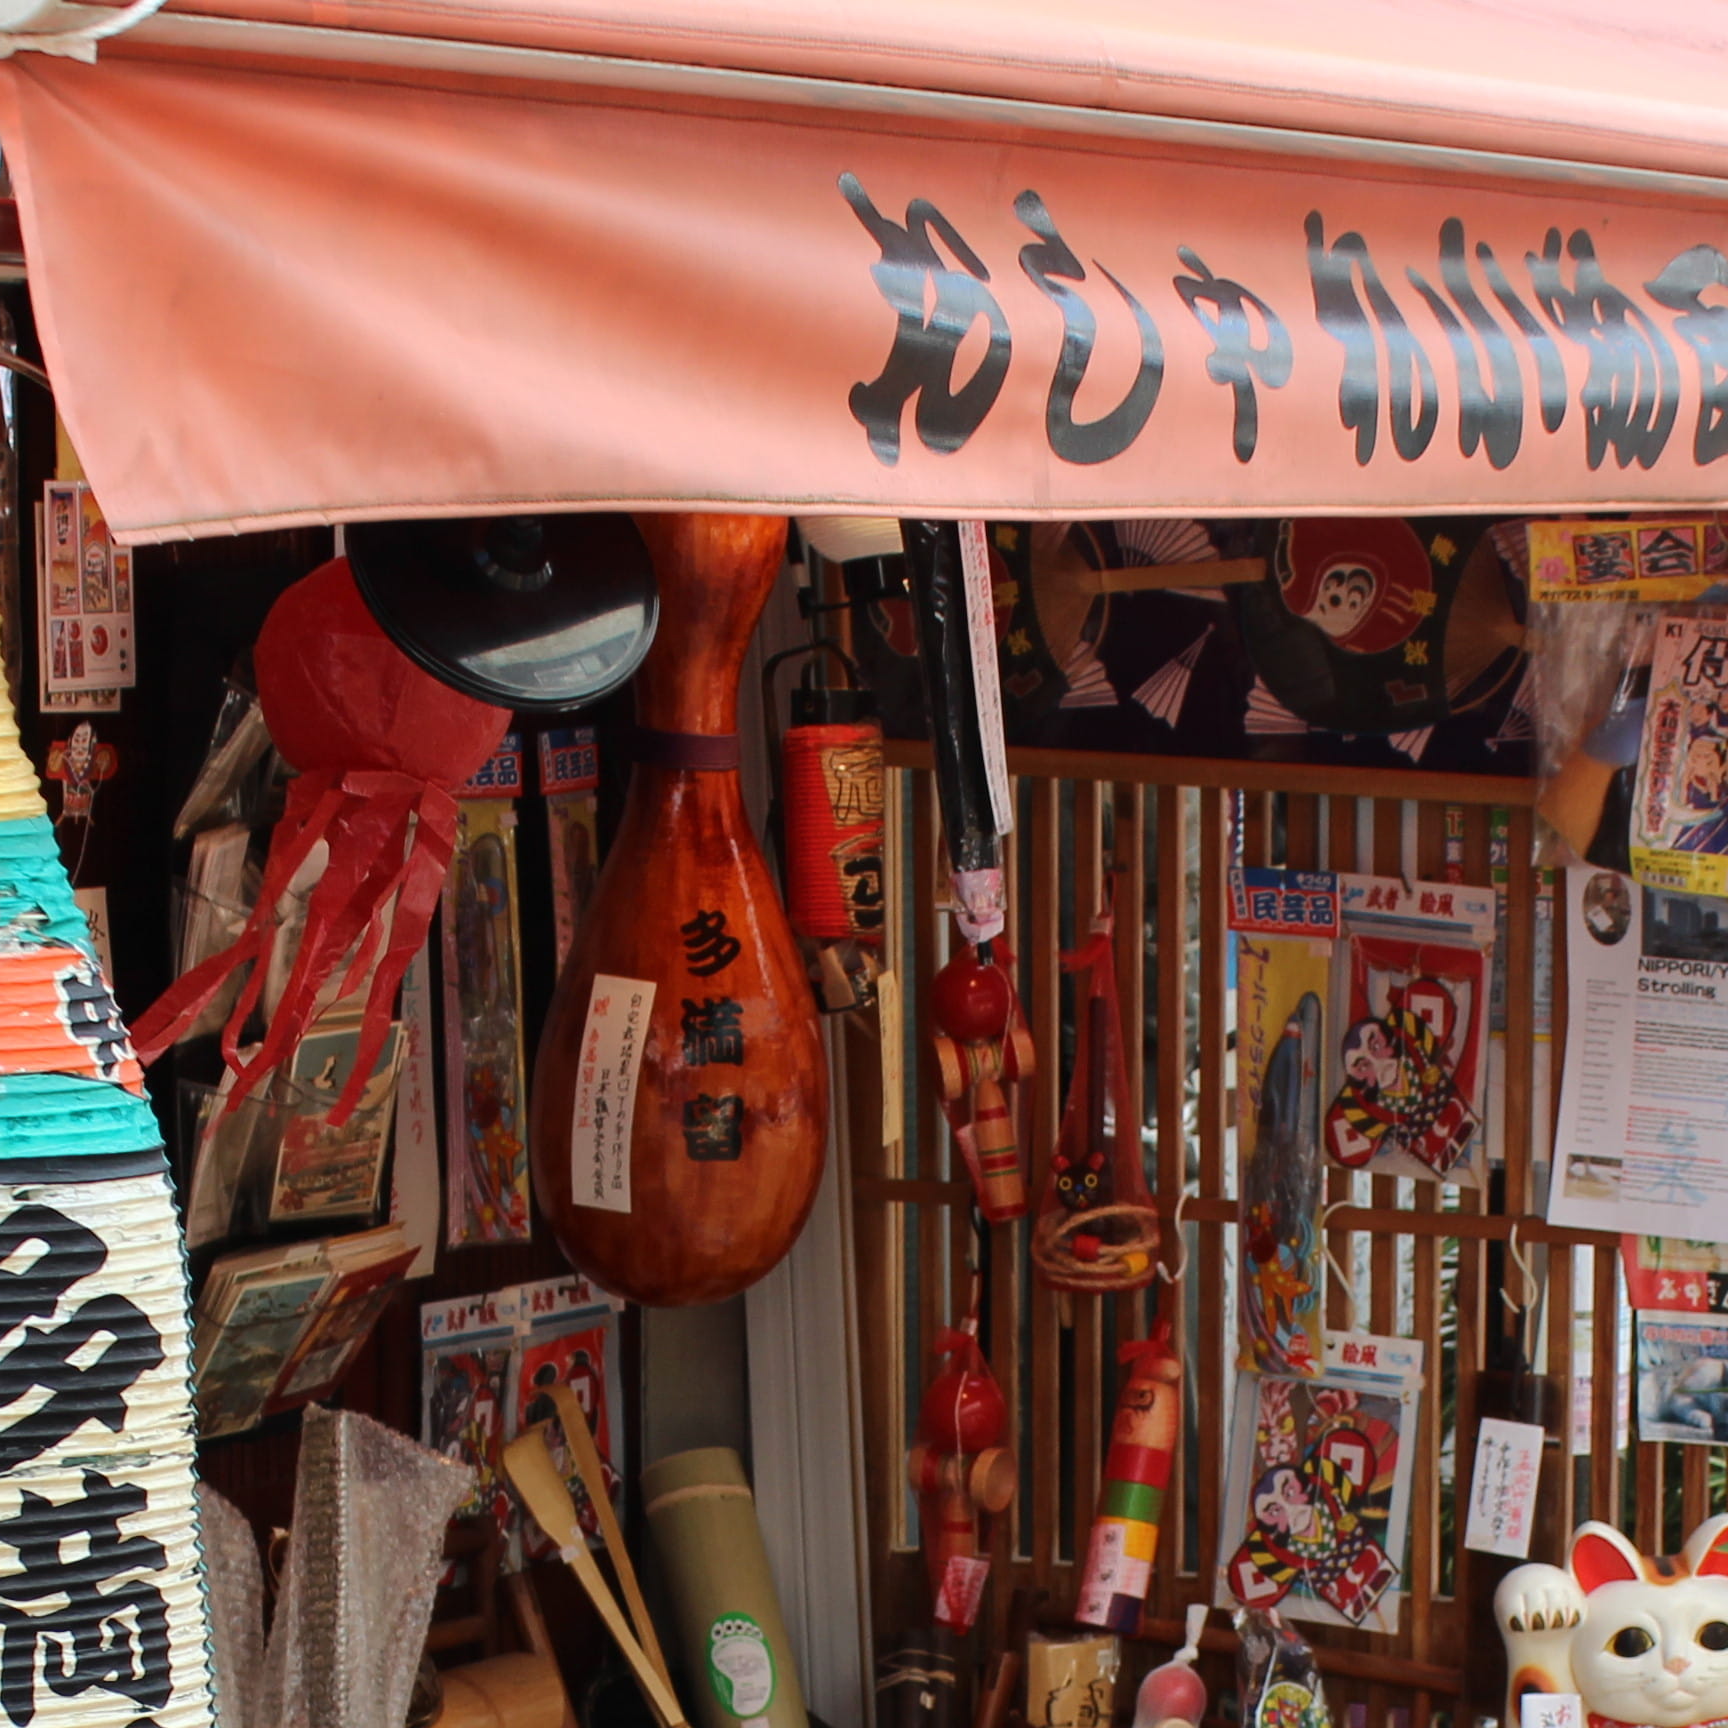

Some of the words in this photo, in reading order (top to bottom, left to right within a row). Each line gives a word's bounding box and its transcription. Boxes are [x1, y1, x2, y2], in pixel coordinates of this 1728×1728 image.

[1251, 890, 1334, 926] 民芸品
[1637, 977, 1717, 999] Strolling
[680, 908, 746, 1162] 多満留
